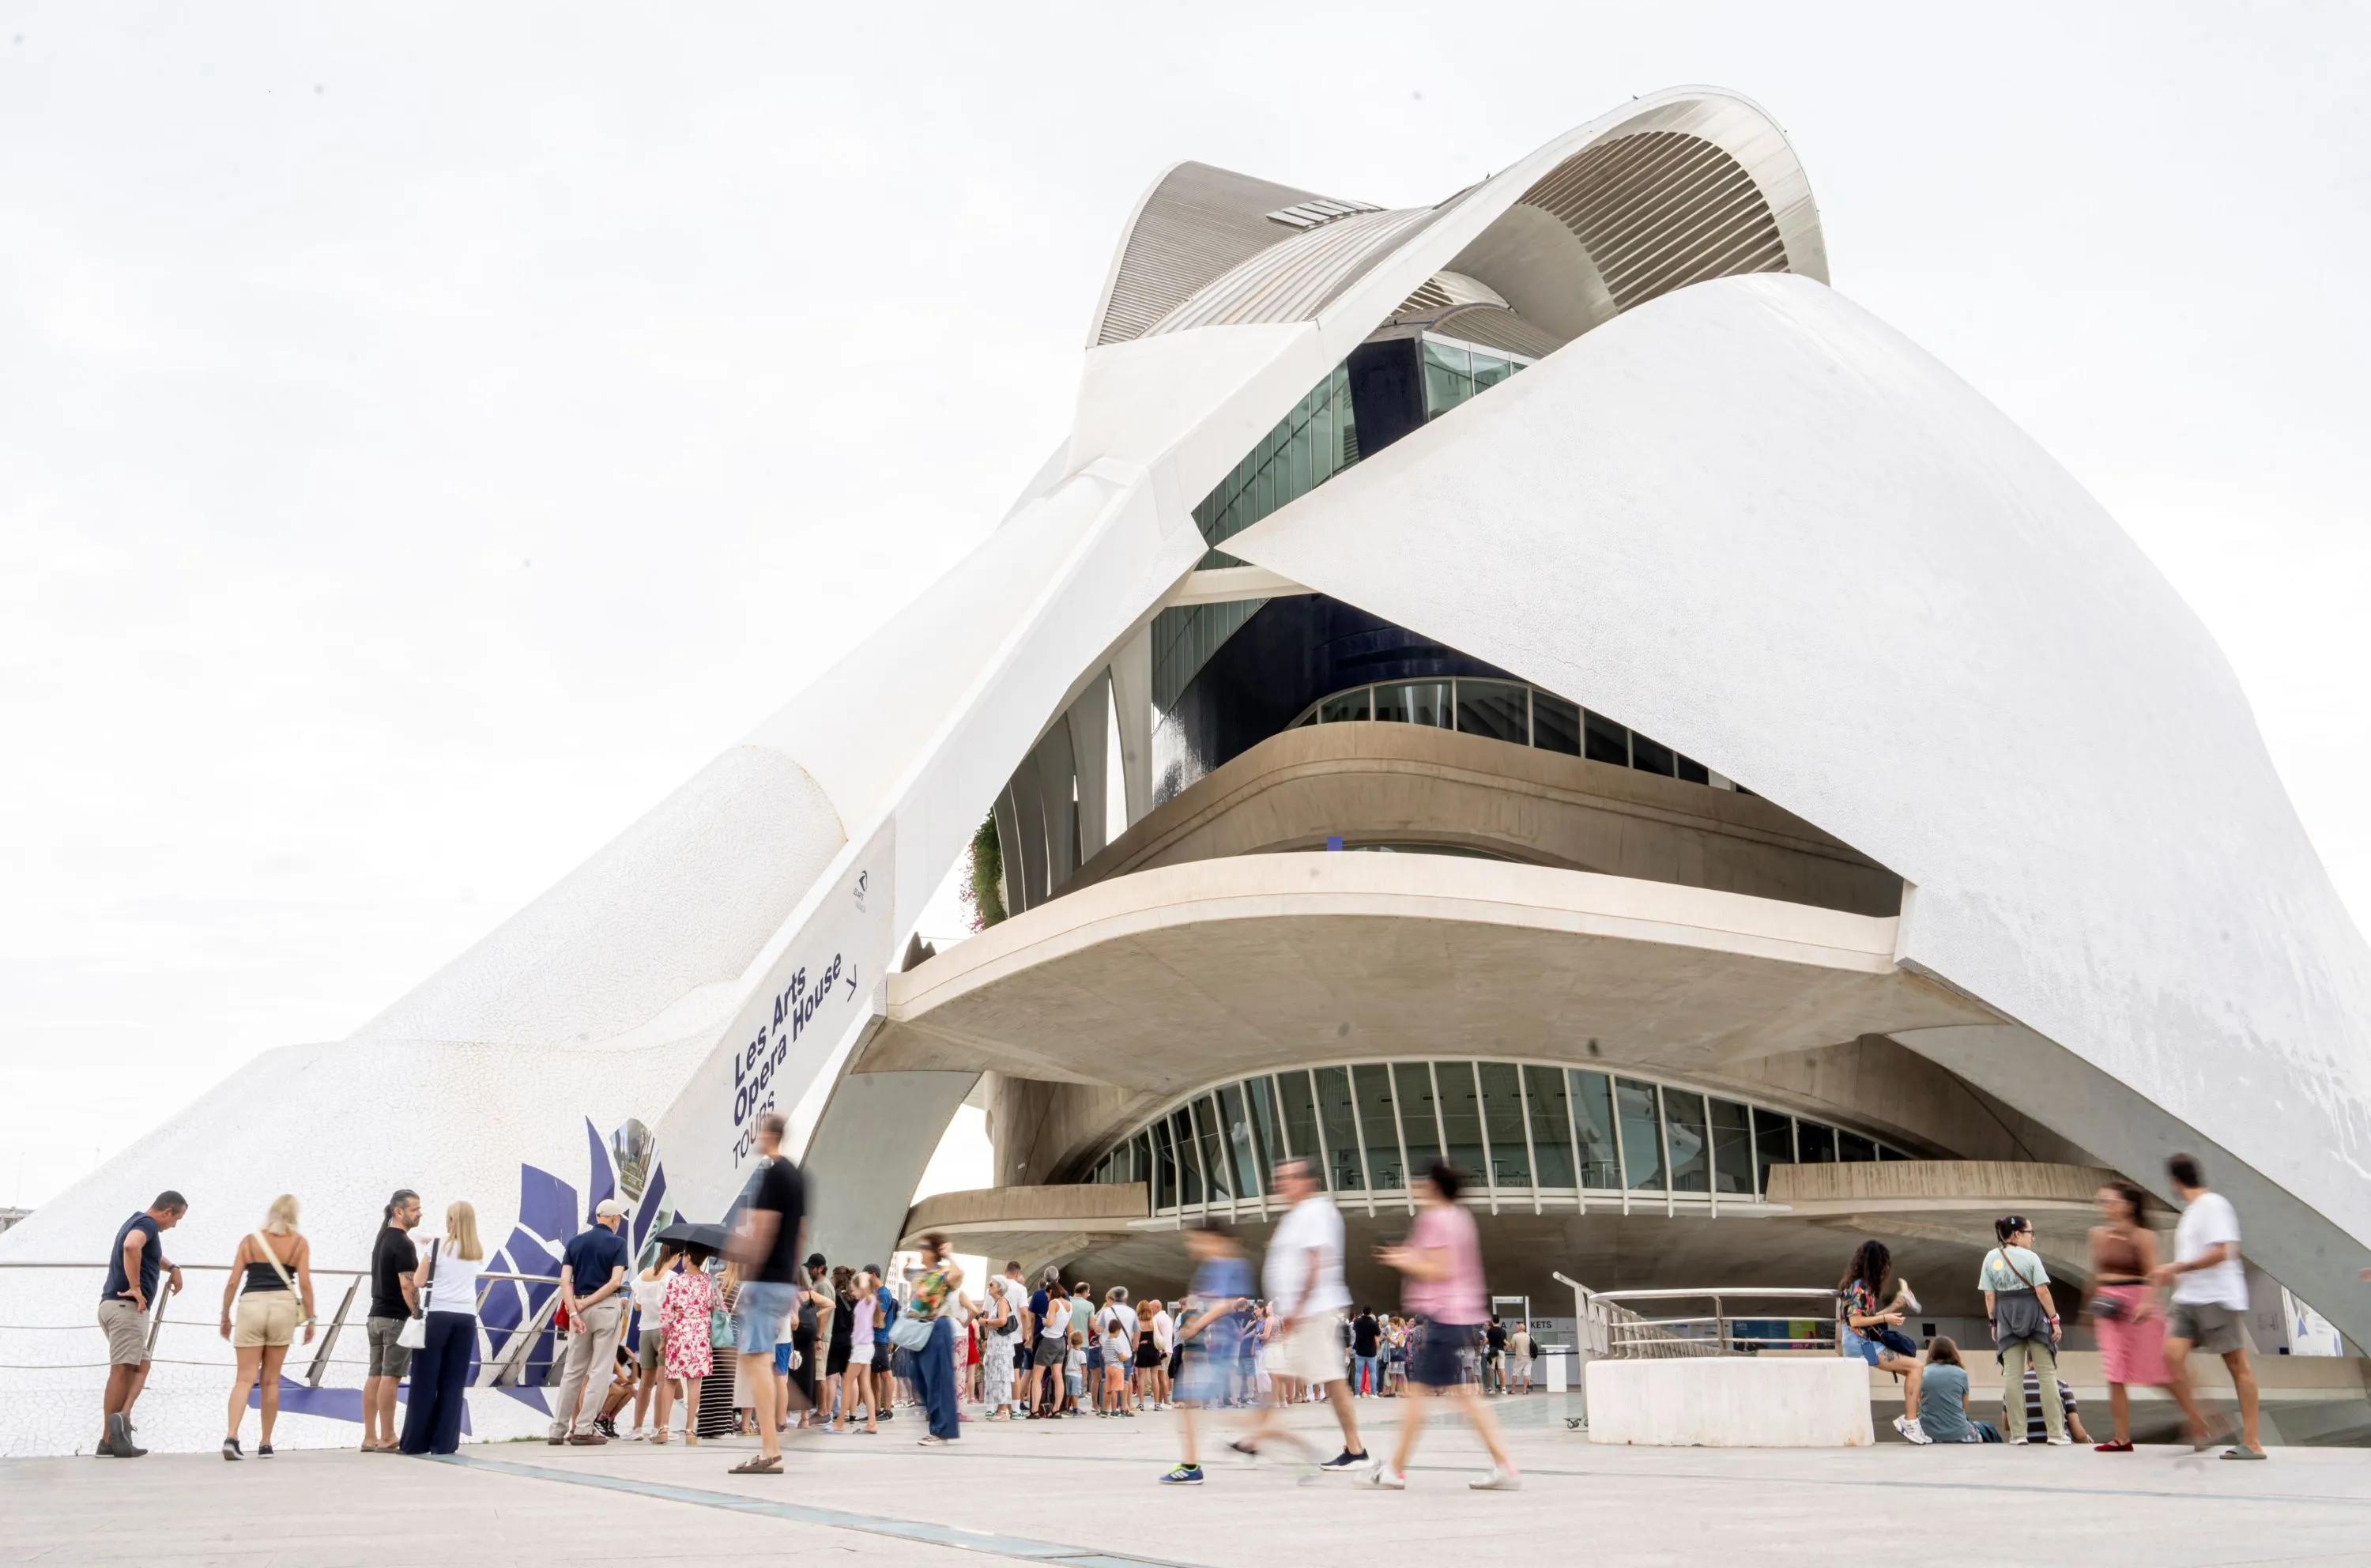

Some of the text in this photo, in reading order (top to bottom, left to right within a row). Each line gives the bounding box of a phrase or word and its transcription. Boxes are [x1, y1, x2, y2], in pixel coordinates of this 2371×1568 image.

[733, 953, 842, 1127] Opera House
[734, 967, 806, 1089] Les Arts
